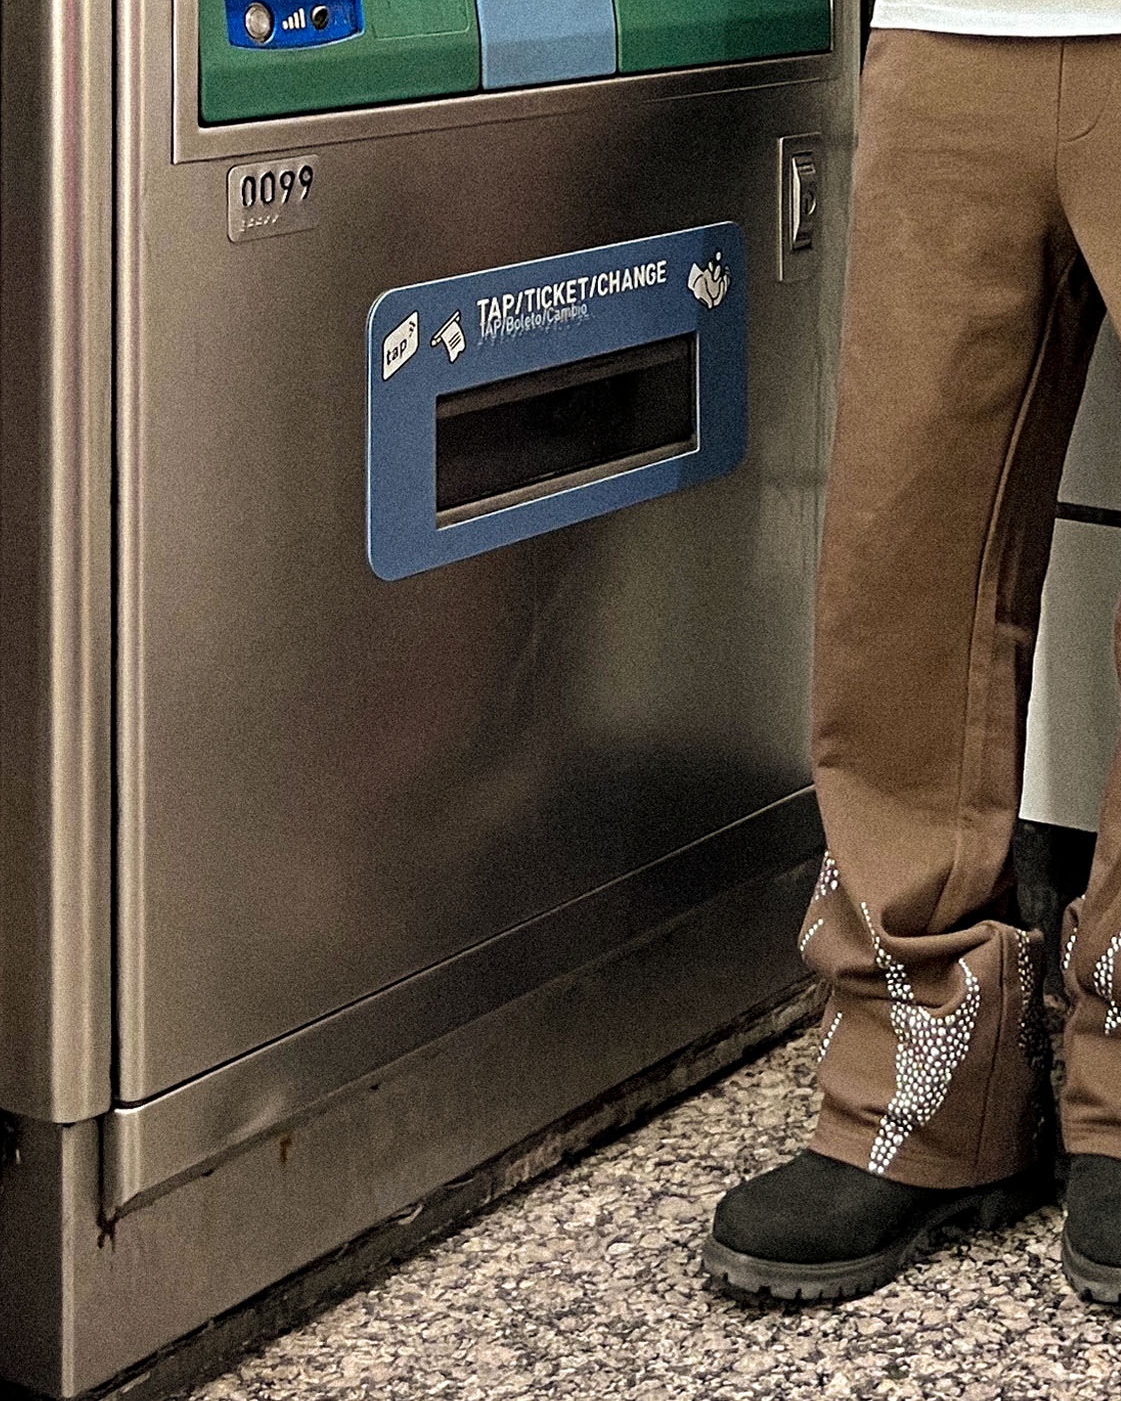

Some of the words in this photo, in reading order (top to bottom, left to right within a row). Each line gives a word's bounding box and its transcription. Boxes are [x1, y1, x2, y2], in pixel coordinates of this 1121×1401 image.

[240, 165, 314, 207] 0099
[477, 260, 668, 326] TAP/TICKET/CHANGE
[386, 339, 408, 365] tap
